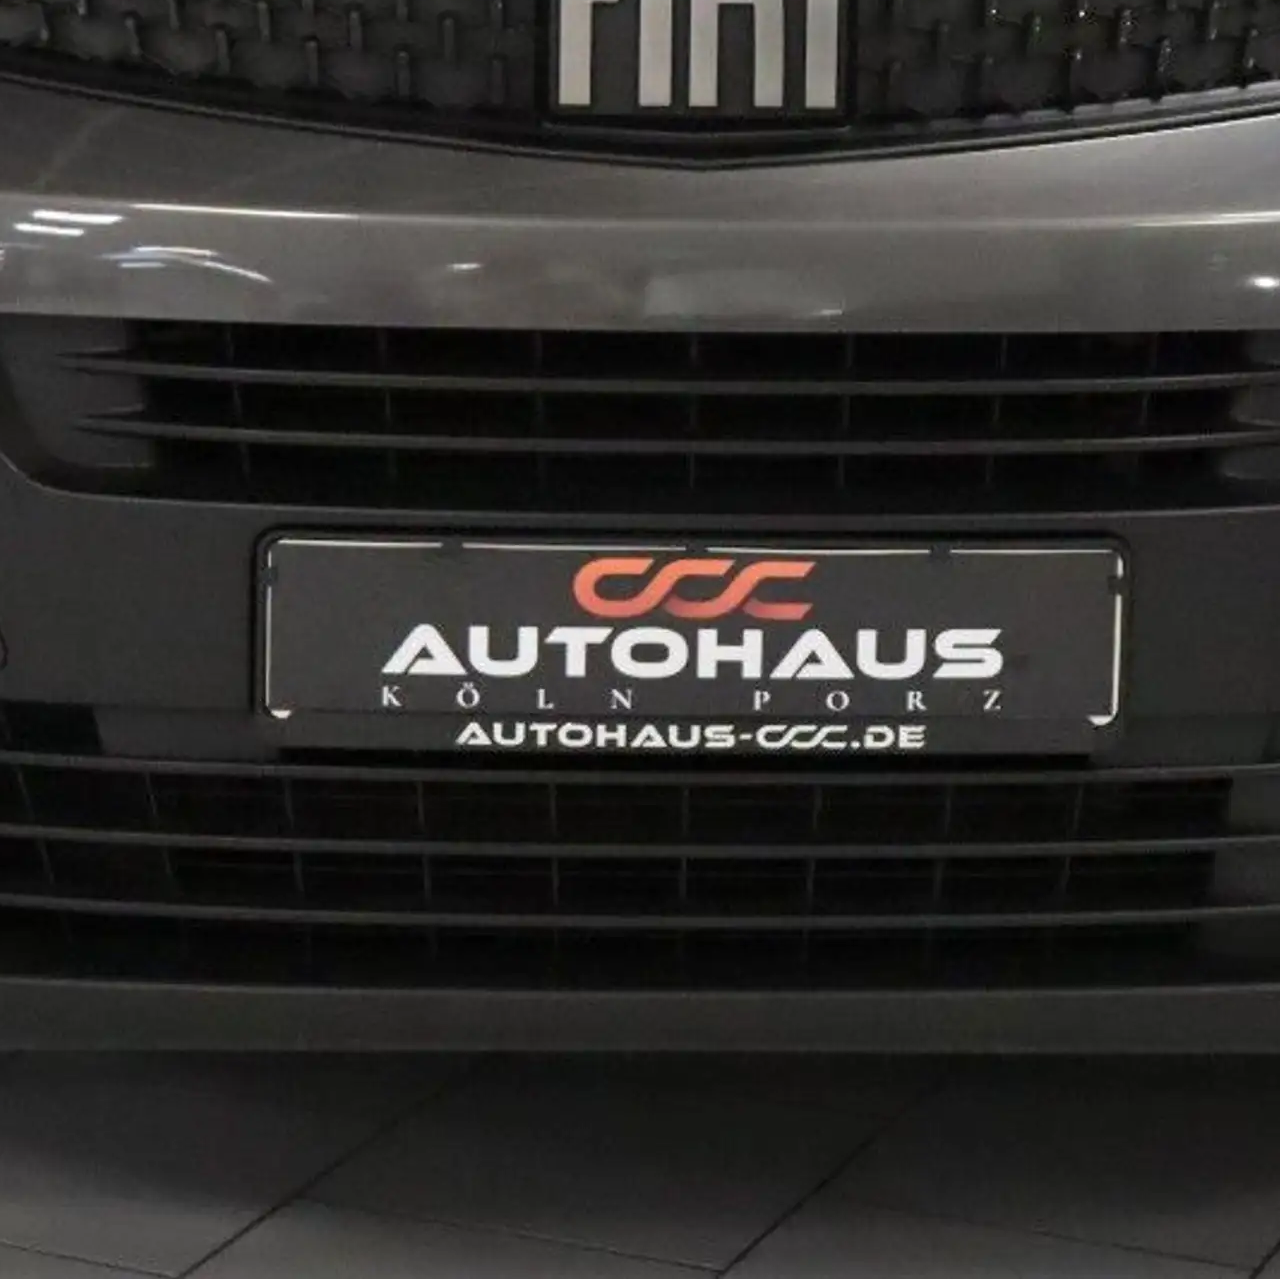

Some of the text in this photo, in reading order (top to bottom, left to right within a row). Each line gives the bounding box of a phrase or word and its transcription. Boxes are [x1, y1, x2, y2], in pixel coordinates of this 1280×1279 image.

[381, 623, 1004, 680] AUTOHAUS
[381, 683, 1003, 712] KÖLN PORZ
[455, 720, 927, 750] AUTOHAUS-CCC.DE
